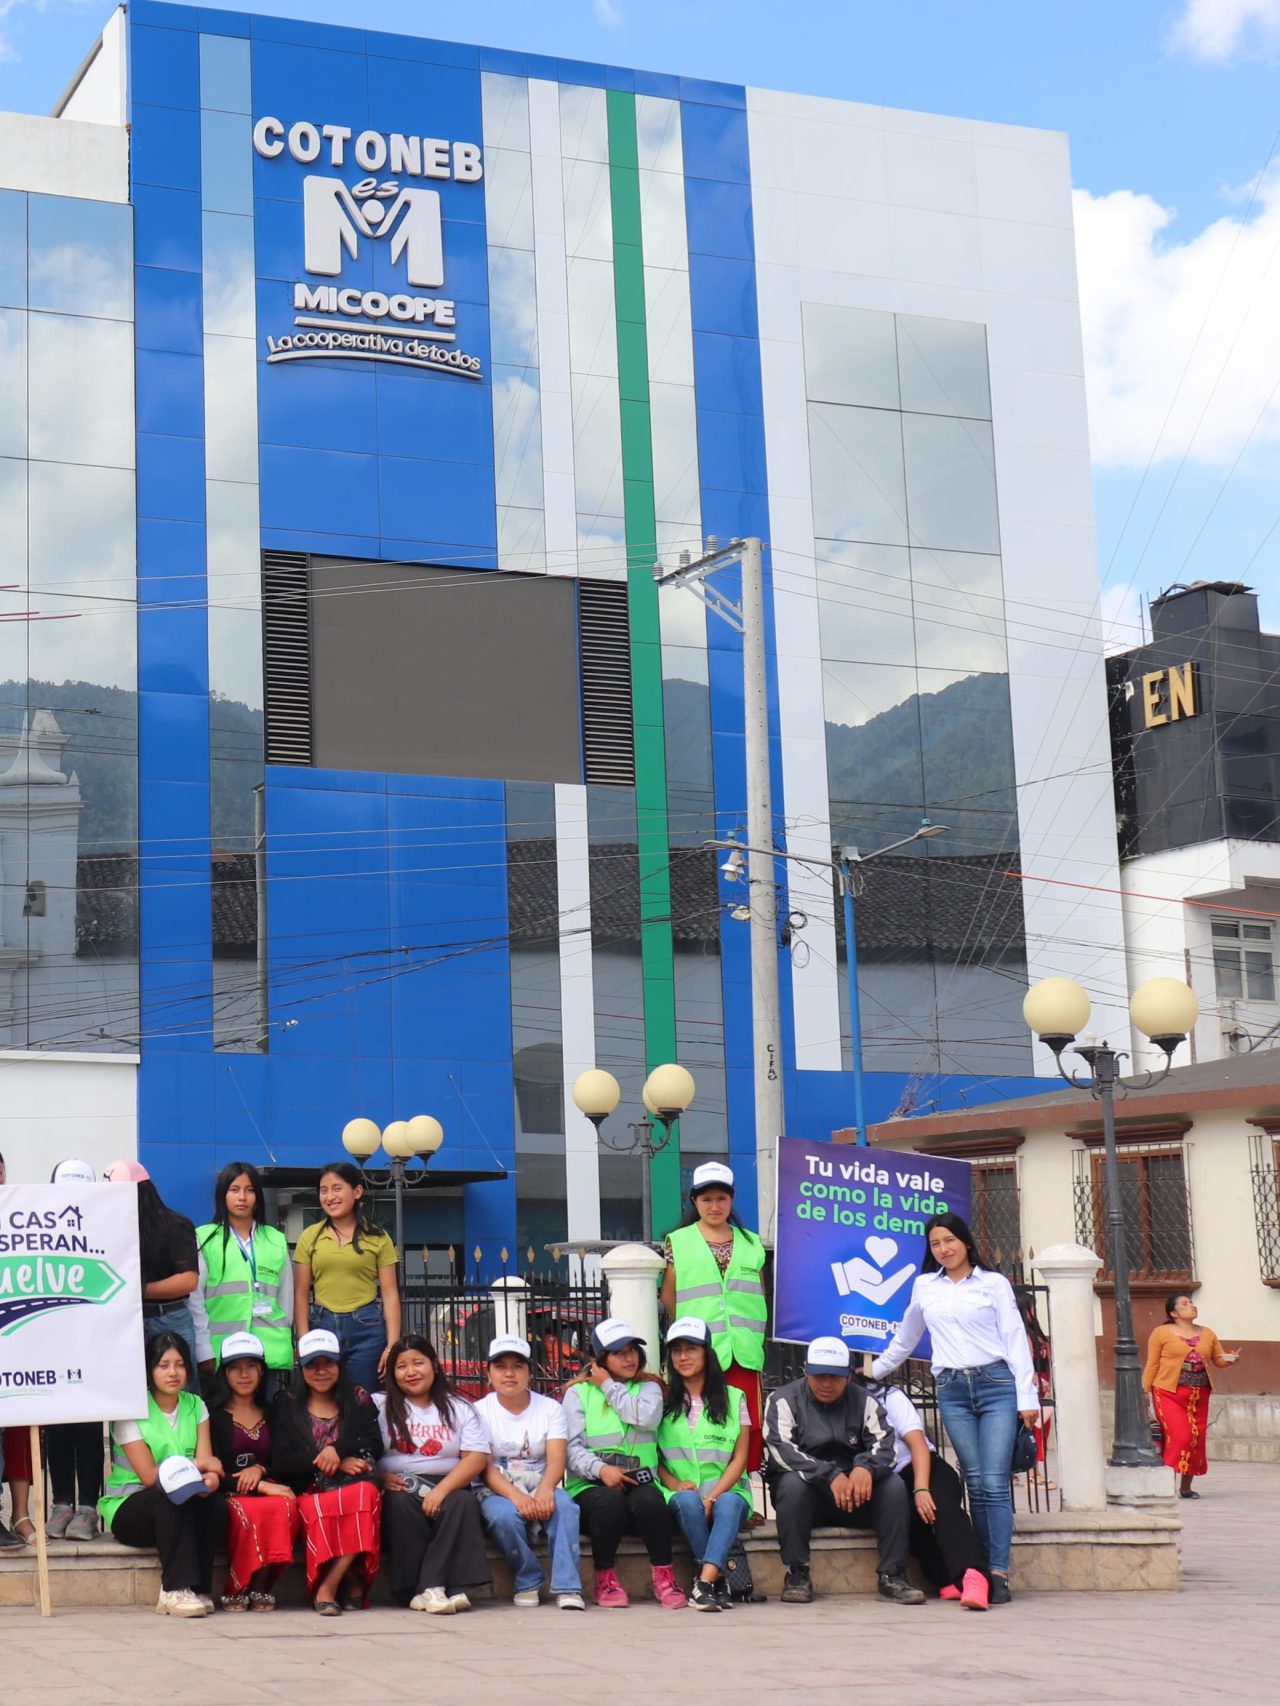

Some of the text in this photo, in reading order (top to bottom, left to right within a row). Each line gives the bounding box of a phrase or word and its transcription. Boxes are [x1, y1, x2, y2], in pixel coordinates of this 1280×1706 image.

[253, 116, 483, 183] COTONEB
[294, 283, 456, 326] MICOOPE
[1143, 662, 1195, 728] EN
[805, 1155, 944, 1193] Tu vida vale
[796, 1200, 826, 1221] de
[833, 1204, 866, 1227] los
[799, 1181, 949, 1215] como la vida
[841, 1315, 887, 1331] COTONEB
